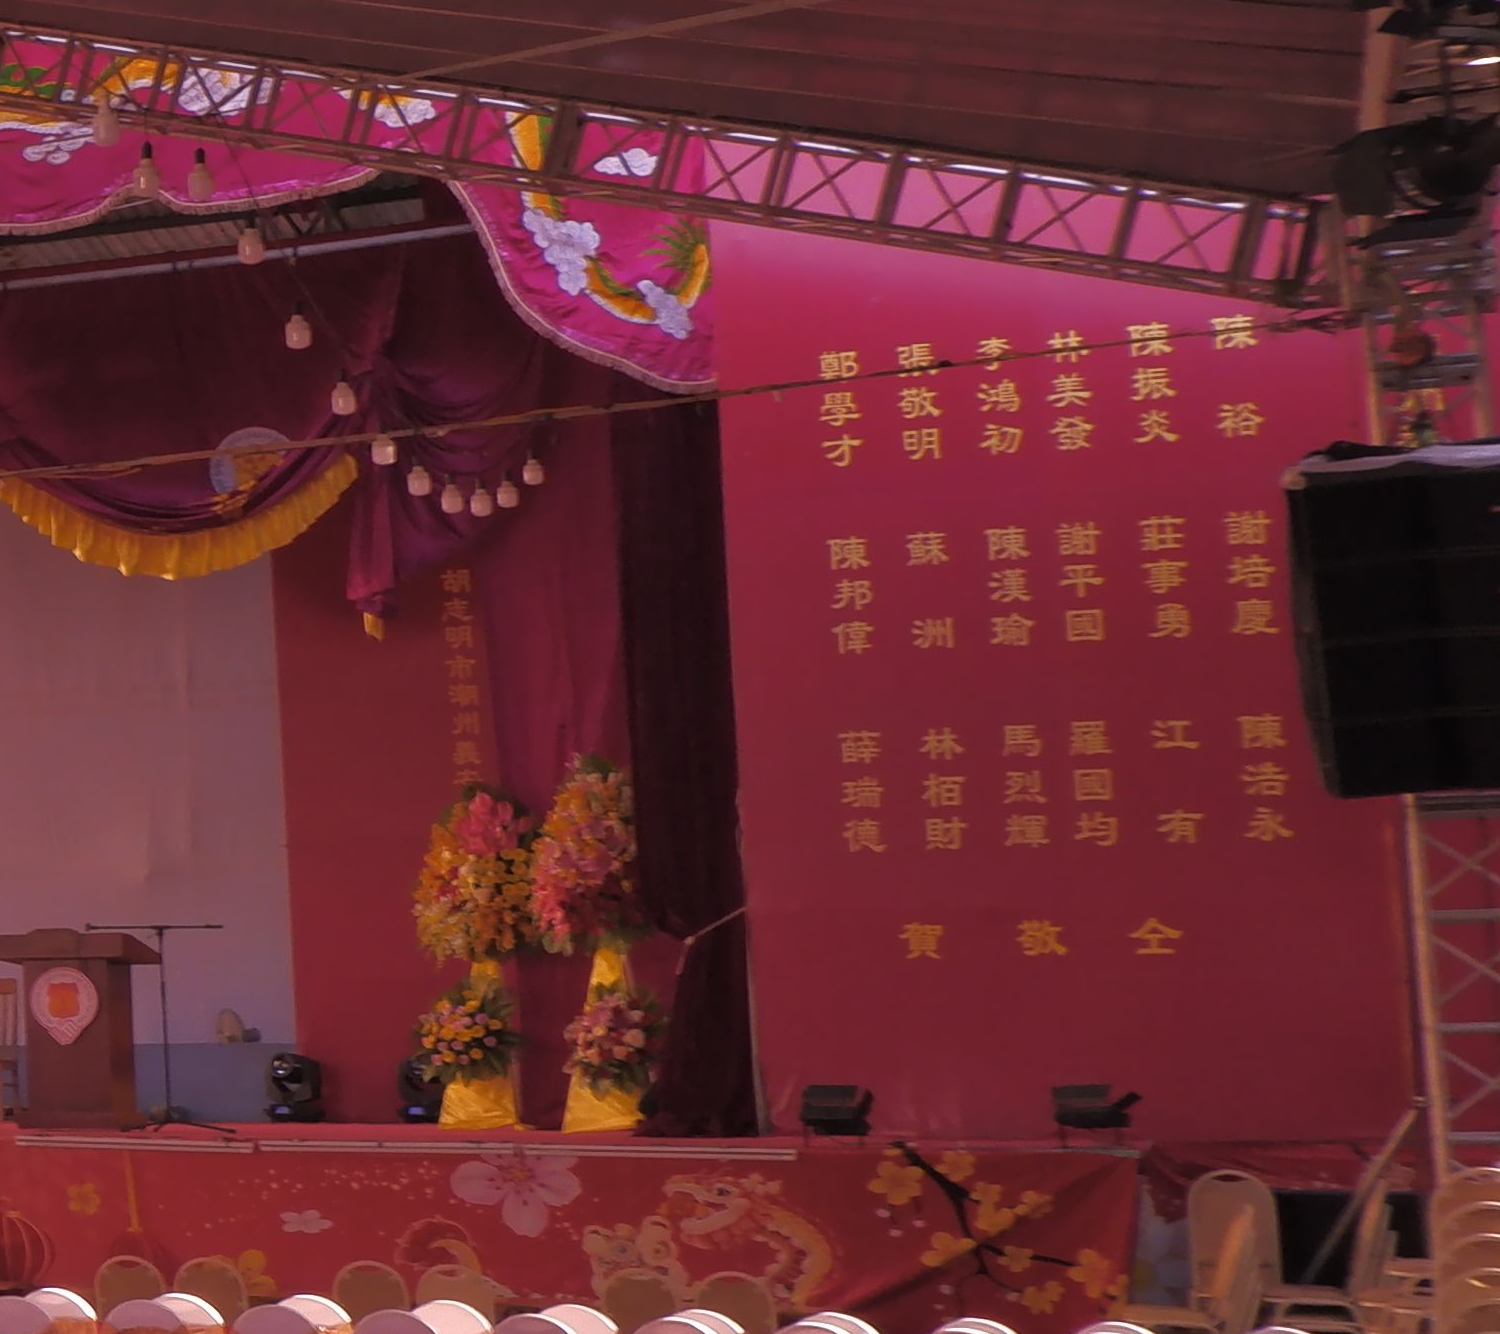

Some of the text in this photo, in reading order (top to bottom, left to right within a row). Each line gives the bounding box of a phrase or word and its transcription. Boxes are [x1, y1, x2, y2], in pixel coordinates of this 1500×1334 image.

[819, 350, 863, 467] 鄭學才
[896, 342, 943, 461] 張敬明
[975, 336, 1023, 456] 李鴻初
[1046, 330, 1095, 452] 林美發
[1126, 321, 1180, 444] 陳振炎
[826, 536, 875, 655] 陳邦偉
[984, 525, 1035, 646] 陳漢瑜
[1054, 521, 1106, 643] 謝平國
[1138, 515, 1192, 639] 莊事勇
[1222, 509, 1281, 636] 謝培慶
[1002, 724, 1050, 848] 馬烈輝
[1070, 720, 1119, 846] 羅國均
[1150, 719, 1204, 844] 江有
[1236, 713, 1294, 843] 陳浩永
